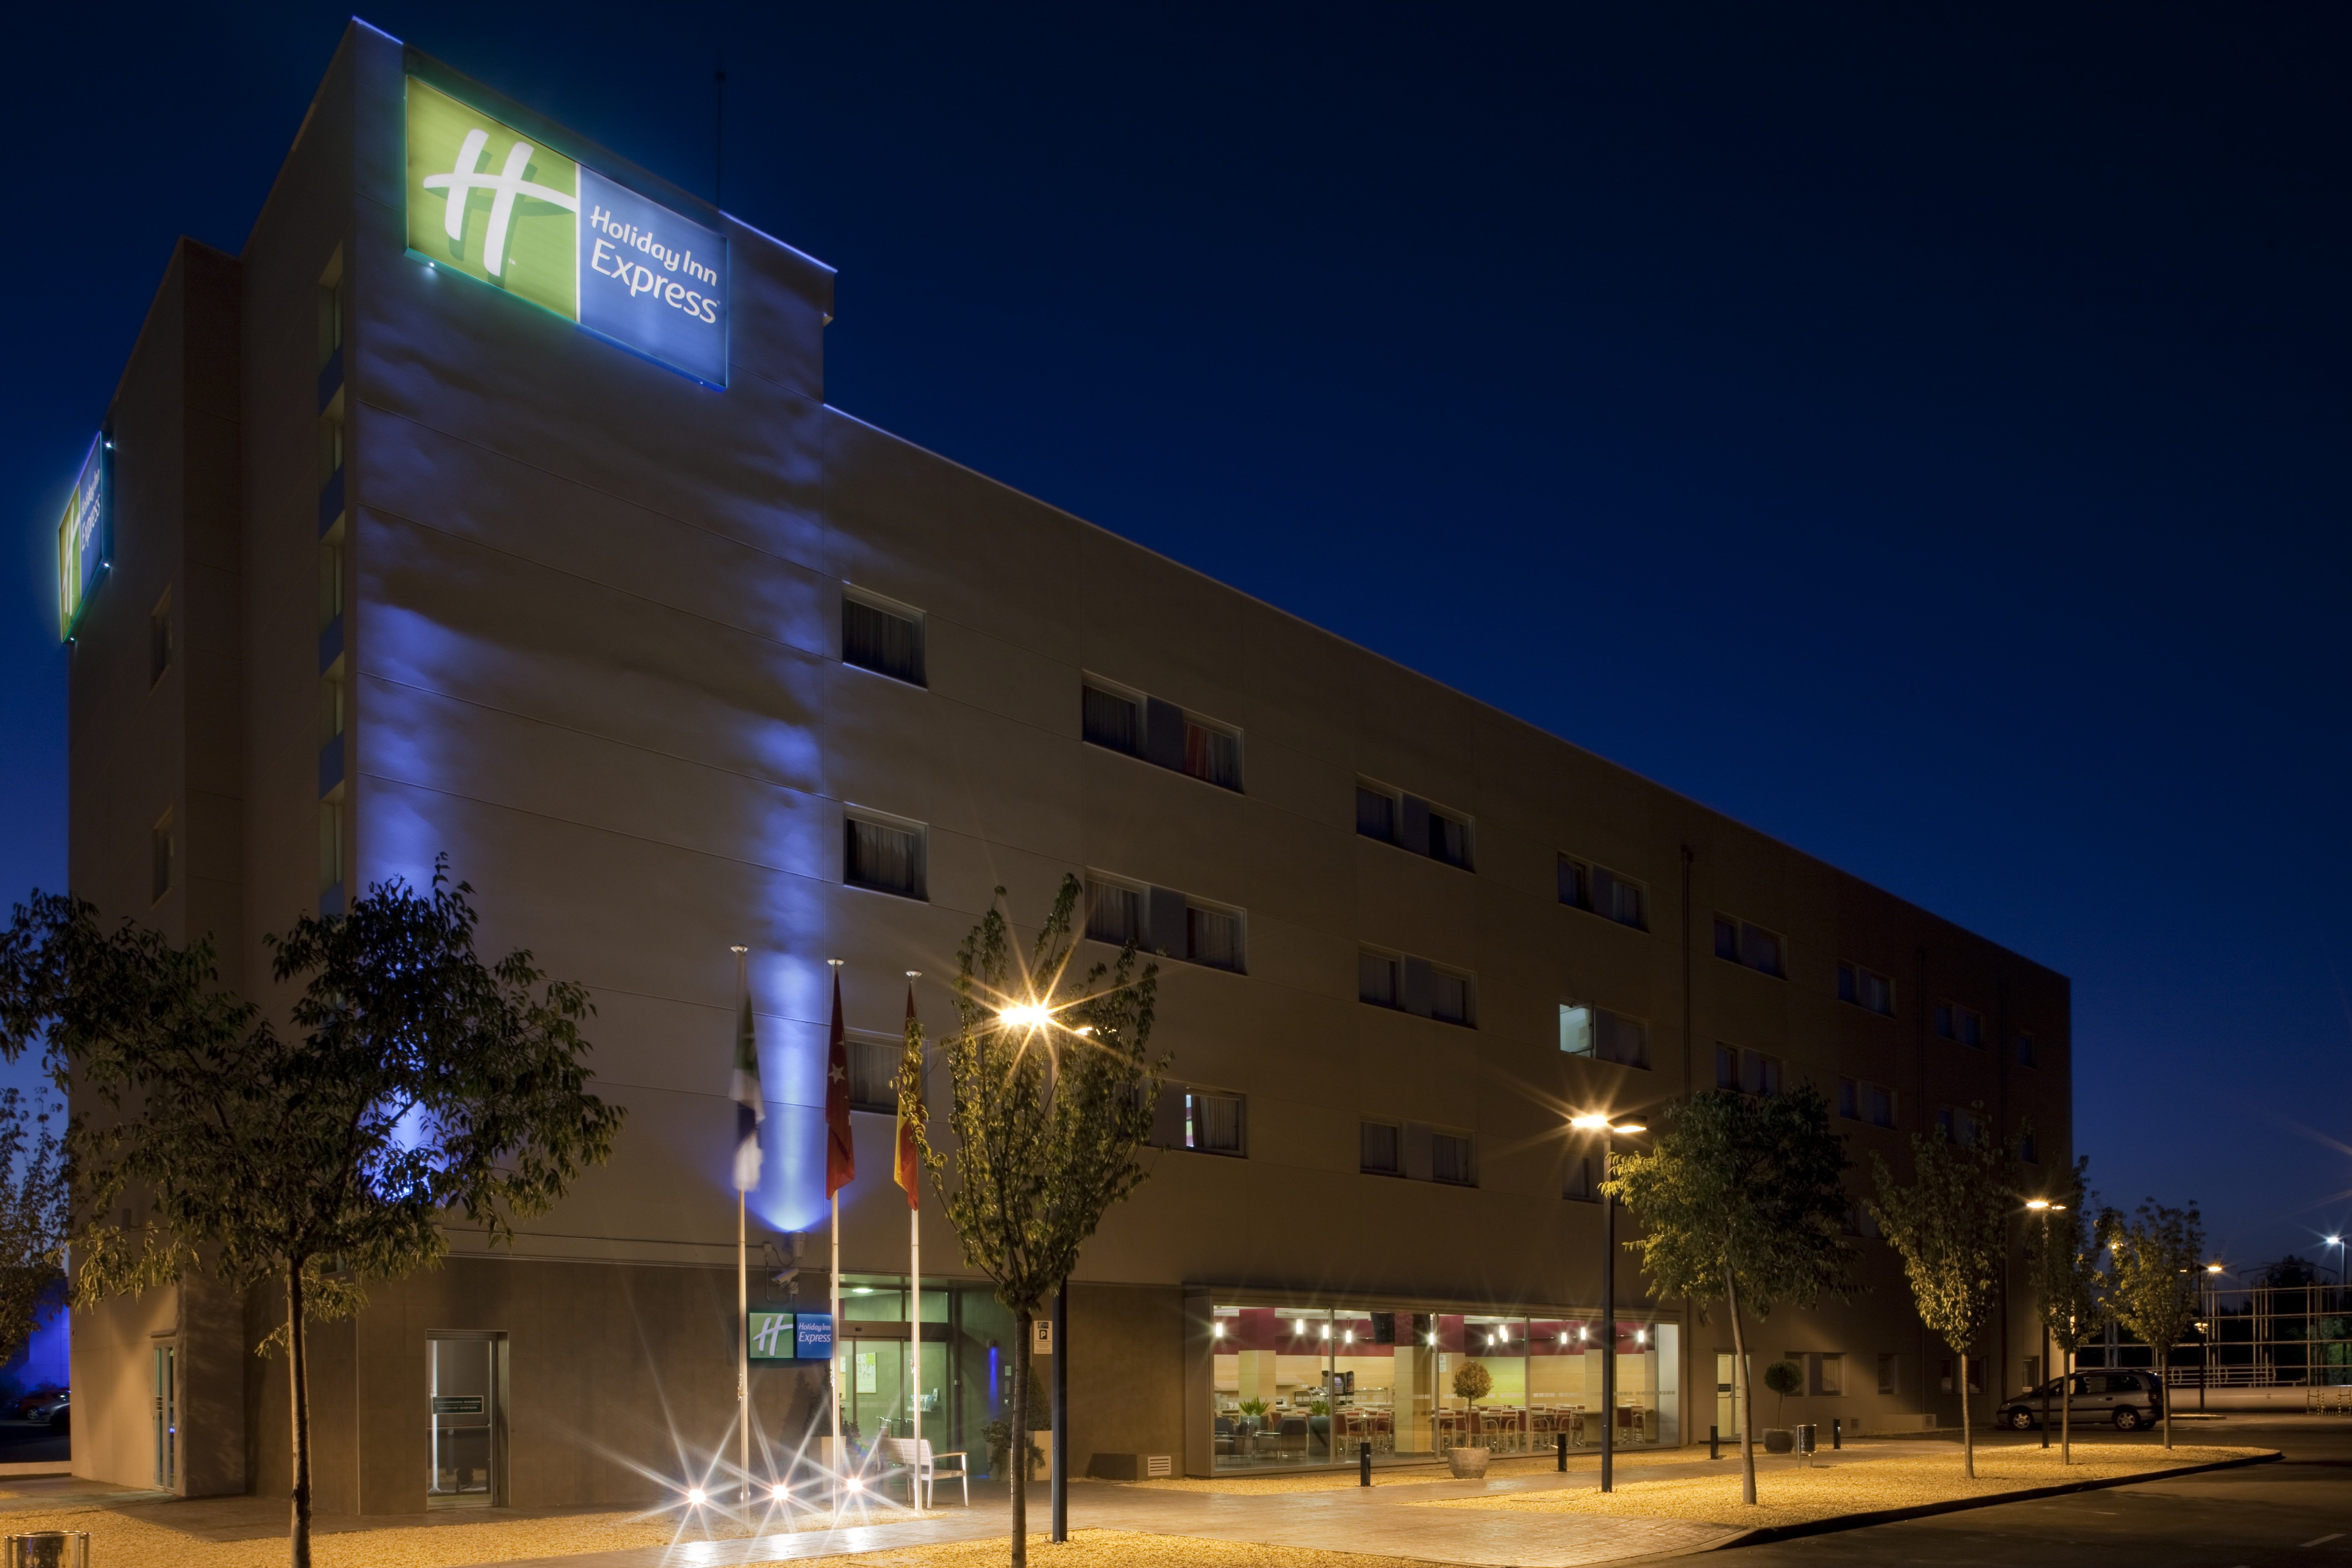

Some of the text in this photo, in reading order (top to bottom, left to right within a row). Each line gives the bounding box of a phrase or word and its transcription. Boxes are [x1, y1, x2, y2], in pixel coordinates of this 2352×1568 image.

[590, 205, 717, 286] Holiday Inn
[591, 237, 717, 323] Express
[82, 494, 100, 552] Express
[799, 1323, 822, 1332] Holiday
[799, 1332, 831, 1344] Express
